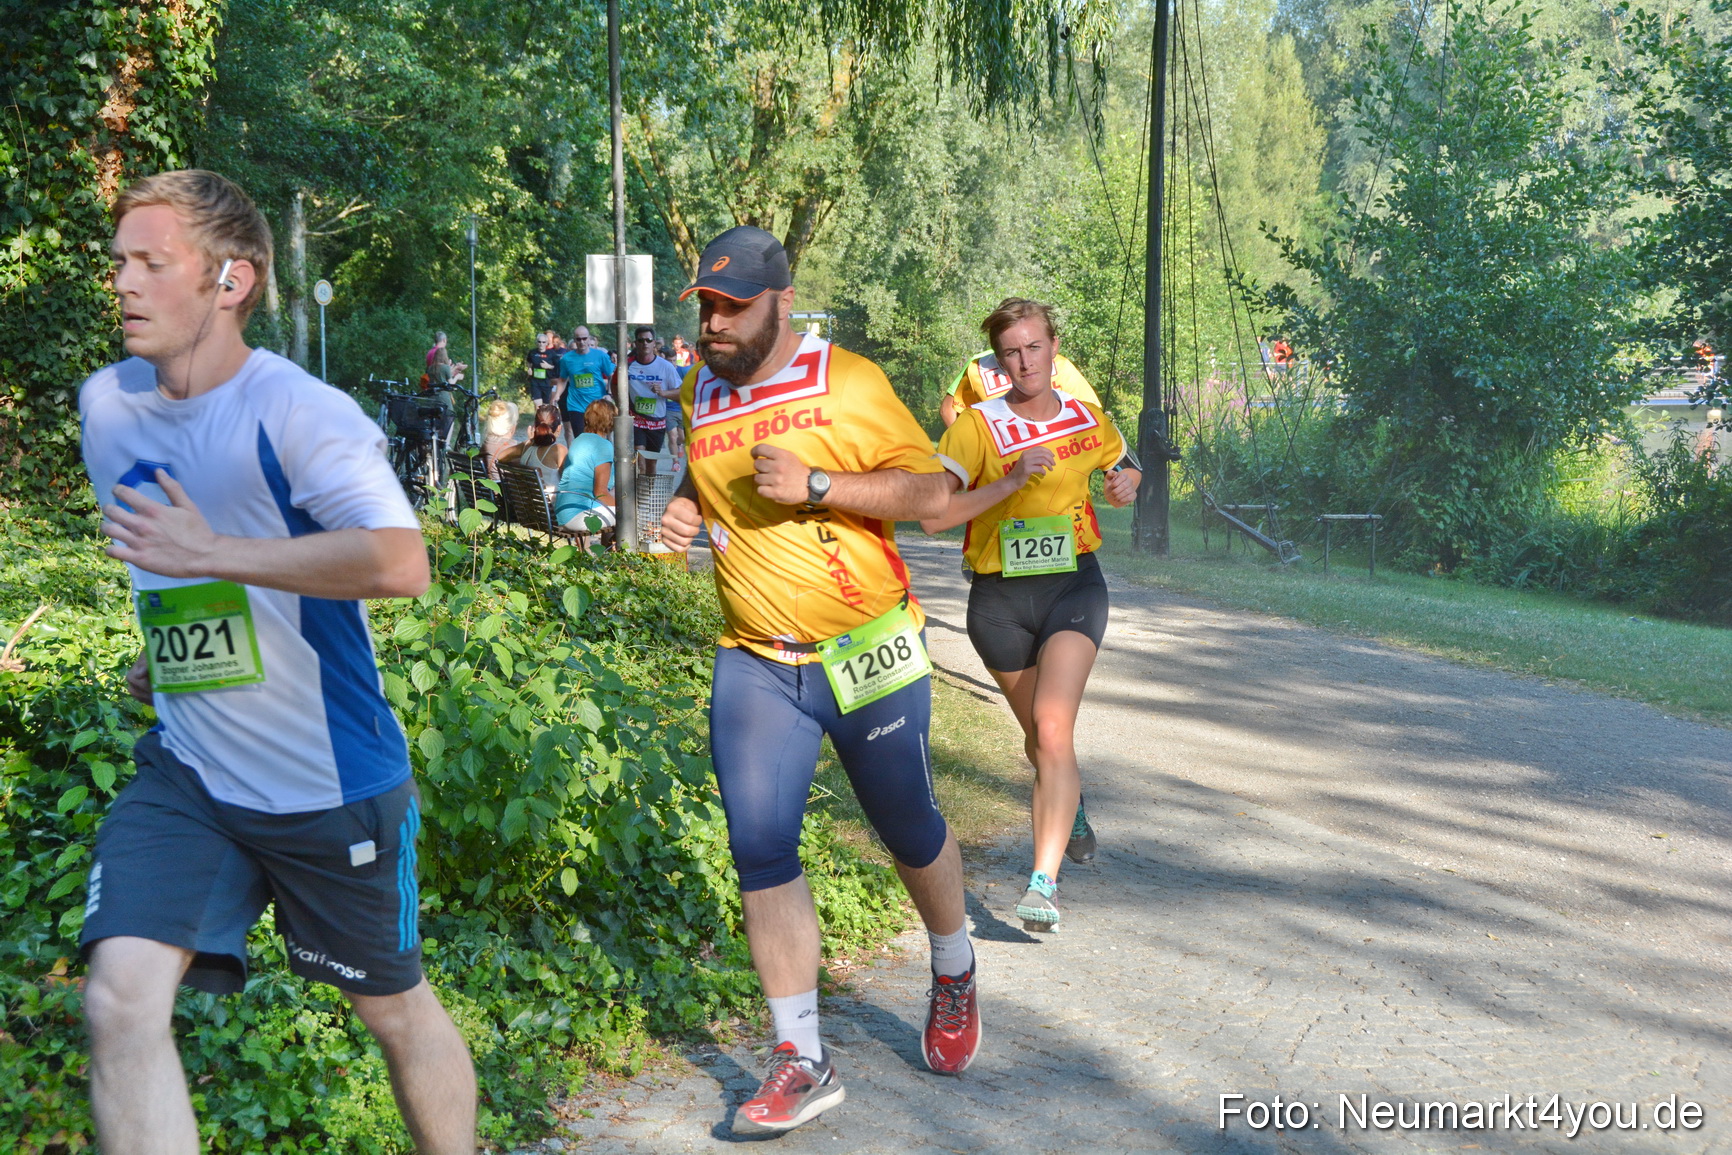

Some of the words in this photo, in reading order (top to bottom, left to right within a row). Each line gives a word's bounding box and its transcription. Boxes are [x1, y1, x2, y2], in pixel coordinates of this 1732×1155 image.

[637, 402, 653, 410] 1751
[689, 427, 744, 463] MAX
[753, 407, 833, 441] BÖGL
[1055, 434, 1102, 460] BÖGL
[1010, 536, 1065, 560] 1267
[1010, 559, 1050, 567] Bierschneider
[151, 619, 236, 663] 2021
[191, 659, 239, 673] Johannes
[841, 635, 912, 685] 1208
[852, 680, 877, 694] Rosca
[877, 661, 914, 683] Constantin
[881, 716, 906, 735] asics
